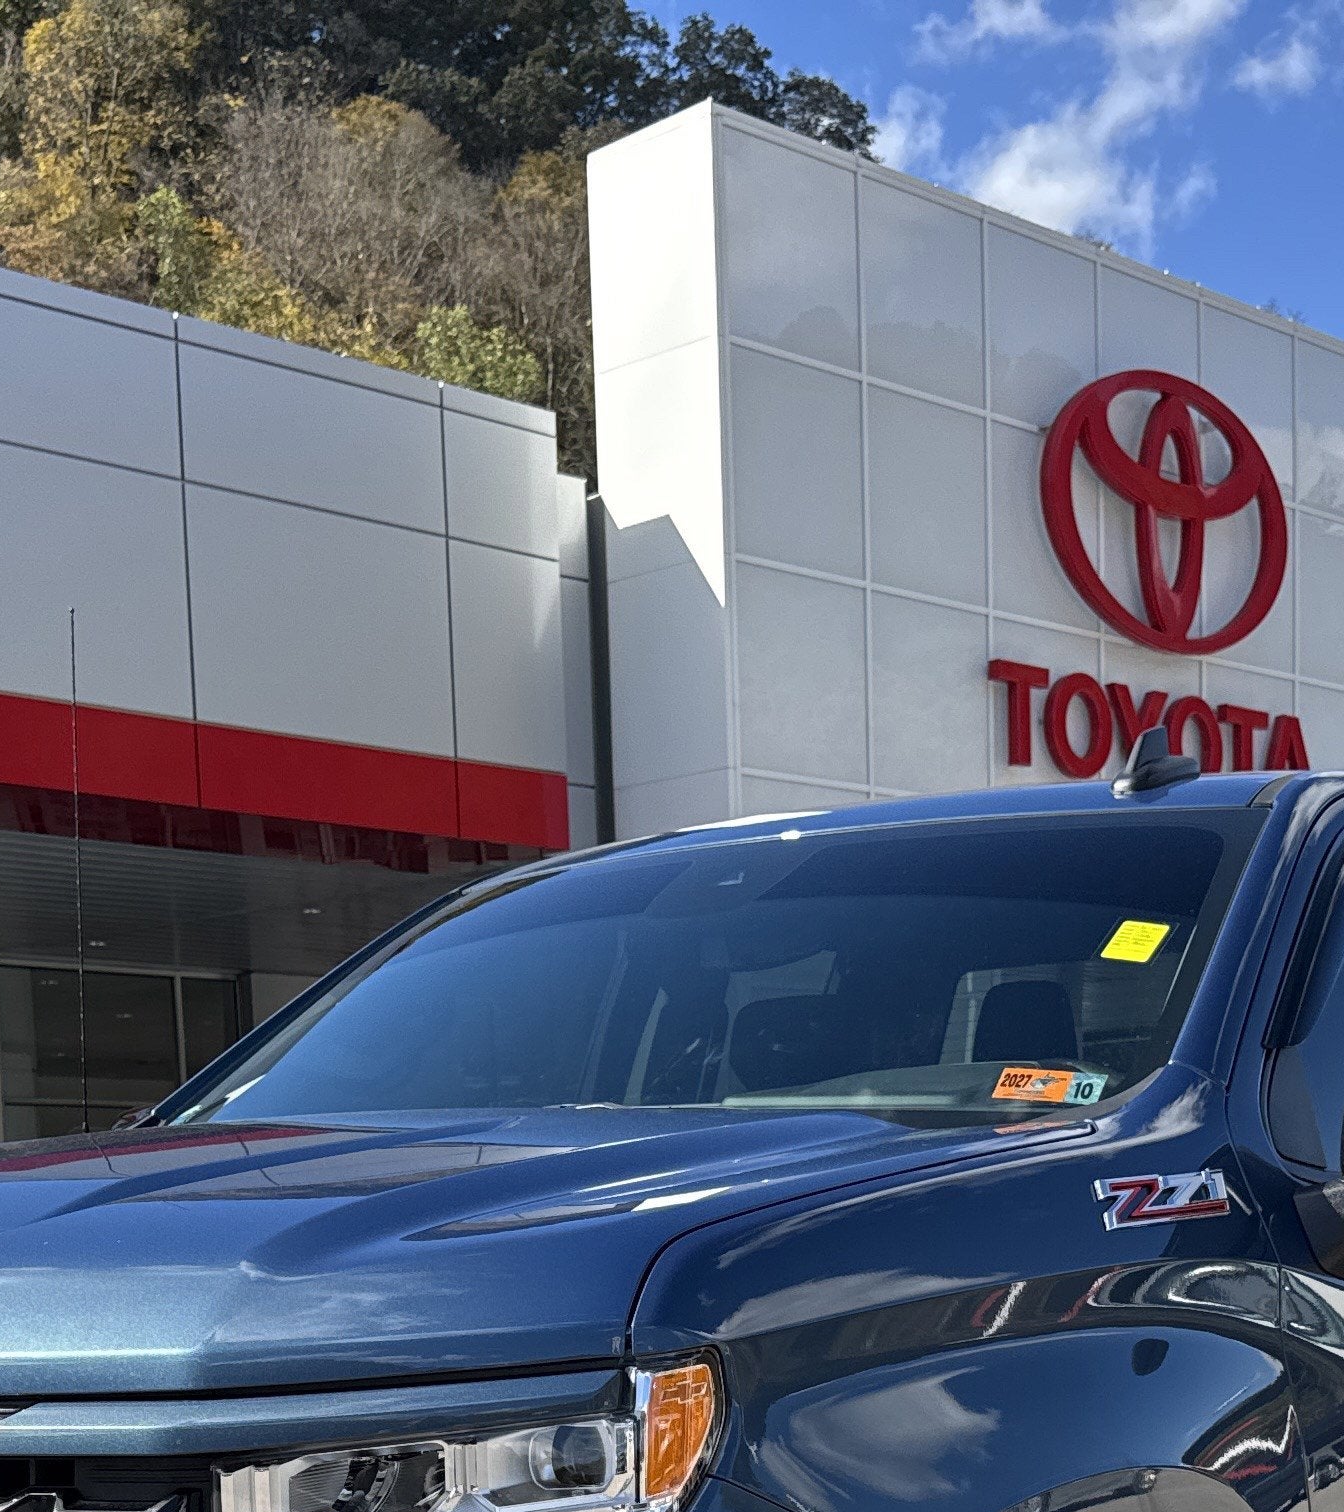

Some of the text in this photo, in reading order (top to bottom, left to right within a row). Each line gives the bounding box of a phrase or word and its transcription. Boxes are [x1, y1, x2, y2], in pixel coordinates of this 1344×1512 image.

[988, 659, 1311, 779] TOYOTA
[999, 1072, 1034, 1089] 2027
[1073, 1081, 1095, 1100] 10
[1092, 1167, 1232, 1232] Z71
